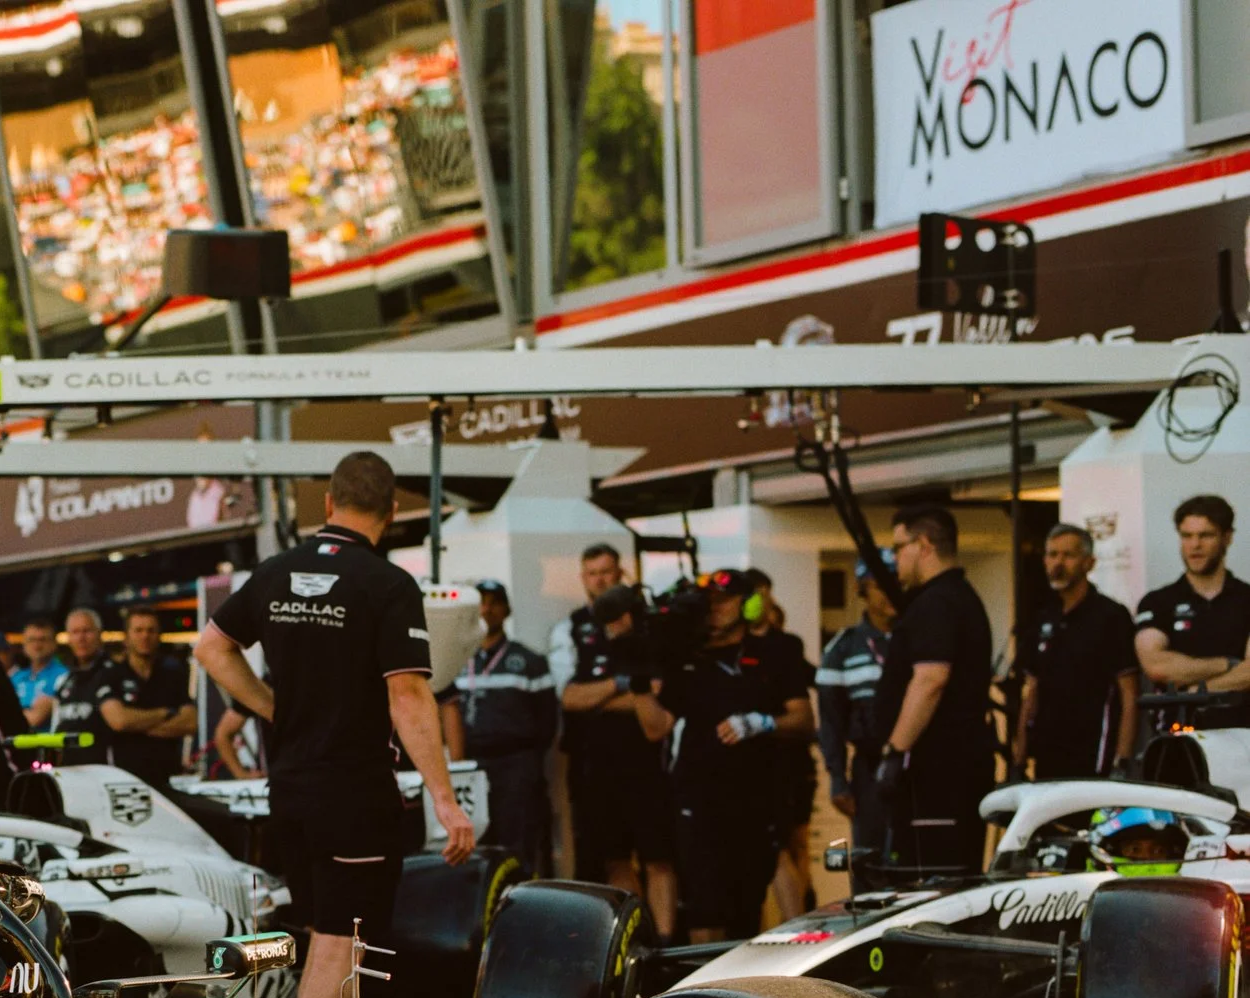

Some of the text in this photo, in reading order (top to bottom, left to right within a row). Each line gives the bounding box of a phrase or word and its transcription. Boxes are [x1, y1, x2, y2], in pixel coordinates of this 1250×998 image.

[910, 31, 1168, 170] MONACO
[65, 369, 212, 389] CADILLAC
[48, 478, 174, 521] COLAPINTO
[991, 888, 1089, 930] Cadilla
[246, 943, 288, 961] PETRONAS
